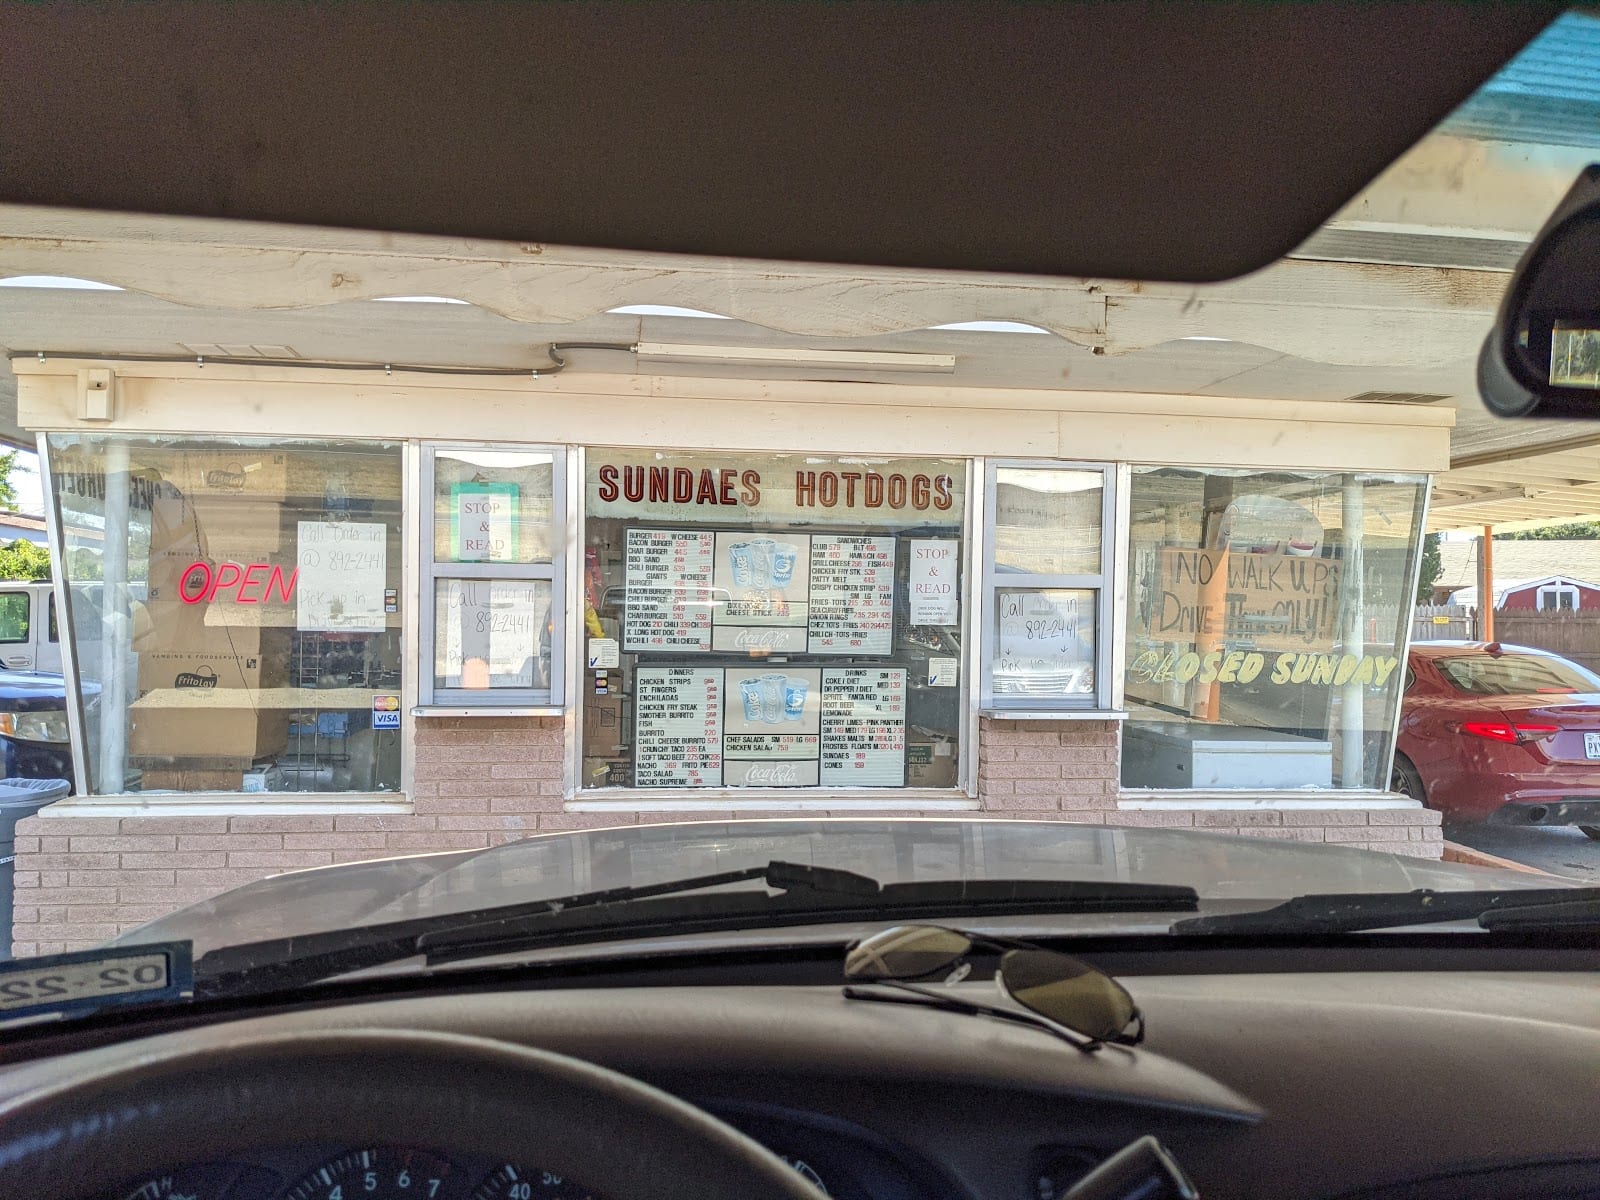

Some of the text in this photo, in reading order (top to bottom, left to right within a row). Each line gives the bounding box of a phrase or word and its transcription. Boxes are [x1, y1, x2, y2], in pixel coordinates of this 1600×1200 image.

[598, 464, 953, 511] SUNDAES HOTDOGS
[465, 503, 500, 514] STOP
[479, 521, 489, 532] &
[466, 539, 504, 551] READ
[916, 548, 949, 559] STOP
[328, 551, 384, 571] 892-2441
[928, 566, 938, 576] &
[1175, 551, 1213, 585] NO
[1228, 555, 1283, 592] WALK
[178, 561, 300, 605] OPEN
[916, 583, 951, 594] READ
[449, 583, 477, 608] Call
[1001, 594, 1025, 619] Call
[475, 611, 530, 633] 892-2441
[1025, 620, 1077, 640] 892-2441
[1130, 650, 1398, 686] CLOSED SUNDAY
[377, 714, 398, 722] VISA
[365, 1172, 377, 1191] 5
[398, 1170, 410, 1188] 6
[428, 1179, 441, 1198] 7
[329, 1184, 343, 1200] 4
[508, 1183, 531, 1200] 40
